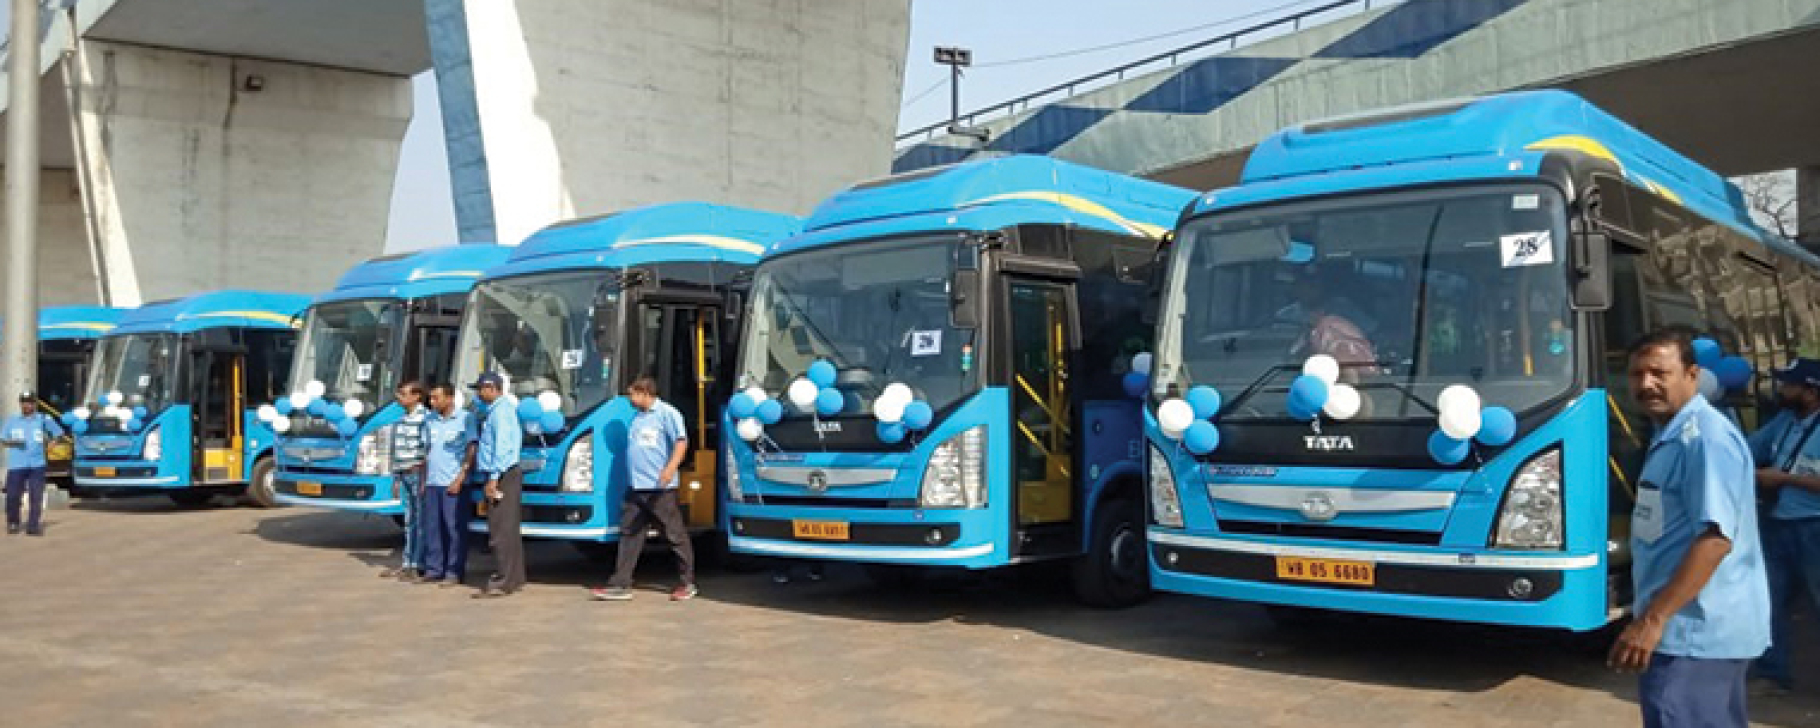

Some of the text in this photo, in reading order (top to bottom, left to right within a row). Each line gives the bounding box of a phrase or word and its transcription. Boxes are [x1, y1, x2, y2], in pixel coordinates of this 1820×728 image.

[1514, 236, 1538, 256] 28
[1303, 435, 1354, 450] TATA
[1285, 562, 1369, 580] WB 05 6680
